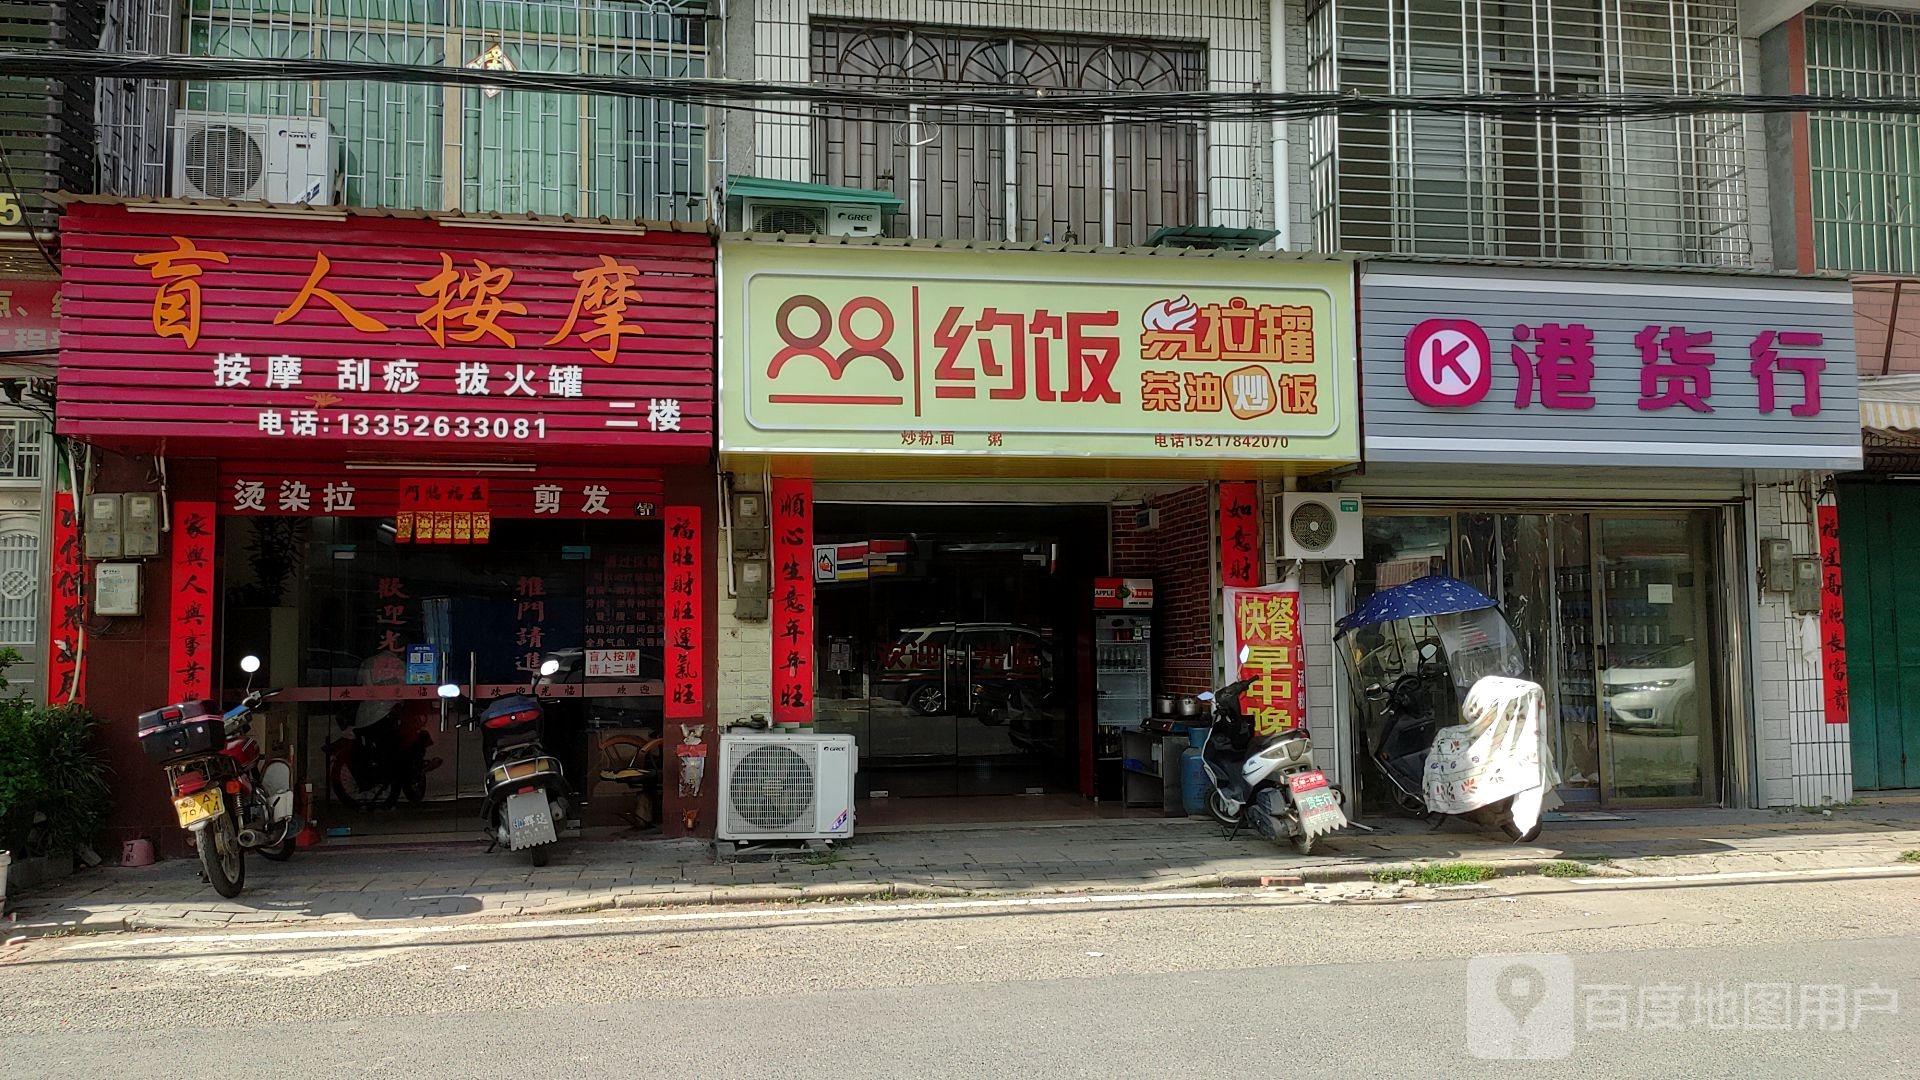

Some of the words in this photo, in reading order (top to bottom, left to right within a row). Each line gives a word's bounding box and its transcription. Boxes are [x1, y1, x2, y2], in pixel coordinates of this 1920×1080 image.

[847, 213, 873, 222] GREE
[133, 235, 645, 364] 盲人按摩
[1141, 294, 1315, 364] 易拉罐
[935, 306, 1121, 403] 约饭
[1432, 338, 1471, 387] K
[1511, 323, 1826, 417] 港货行
[214, 353, 303, 389] 按摩
[337, 358, 420, 392] 刮痧
[455, 362, 583, 397] 拔火罐
[1141, 369, 1318, 417] 茶油炒饭
[258, 409, 547, 439] 电话:13352633081
[605, 399, 681, 431] 二楼
[987, 432, 1003, 447] 粥
[1154, 433, 1289, 449] 电话15217842070
[234, 480, 355, 512] 烫染拉
[533, 484, 610, 515] 剪发
[1238, 595, 1294, 641] 快餐
[590, 651, 636, 662] 盲人按摩
[590, 664, 636, 674] 请上二楼
[1243, 645, 1293, 736] 早中晚
